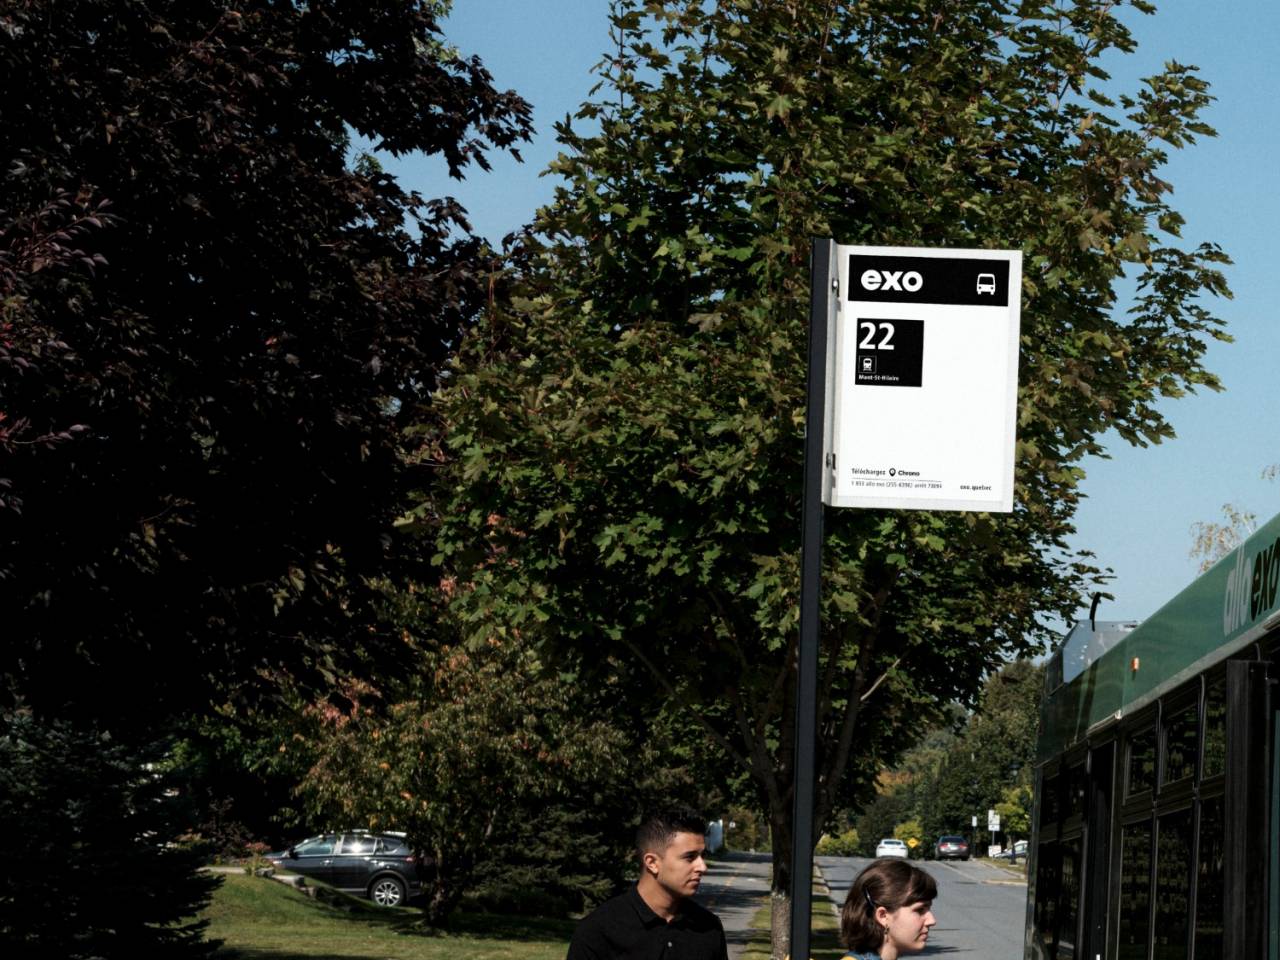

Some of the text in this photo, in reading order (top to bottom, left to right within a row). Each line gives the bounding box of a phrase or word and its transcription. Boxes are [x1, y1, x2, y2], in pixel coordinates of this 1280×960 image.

[860, 269, 924, 292] exo
[858, 322, 895, 350] 22
[1250, 536, 1280, 622] exo
